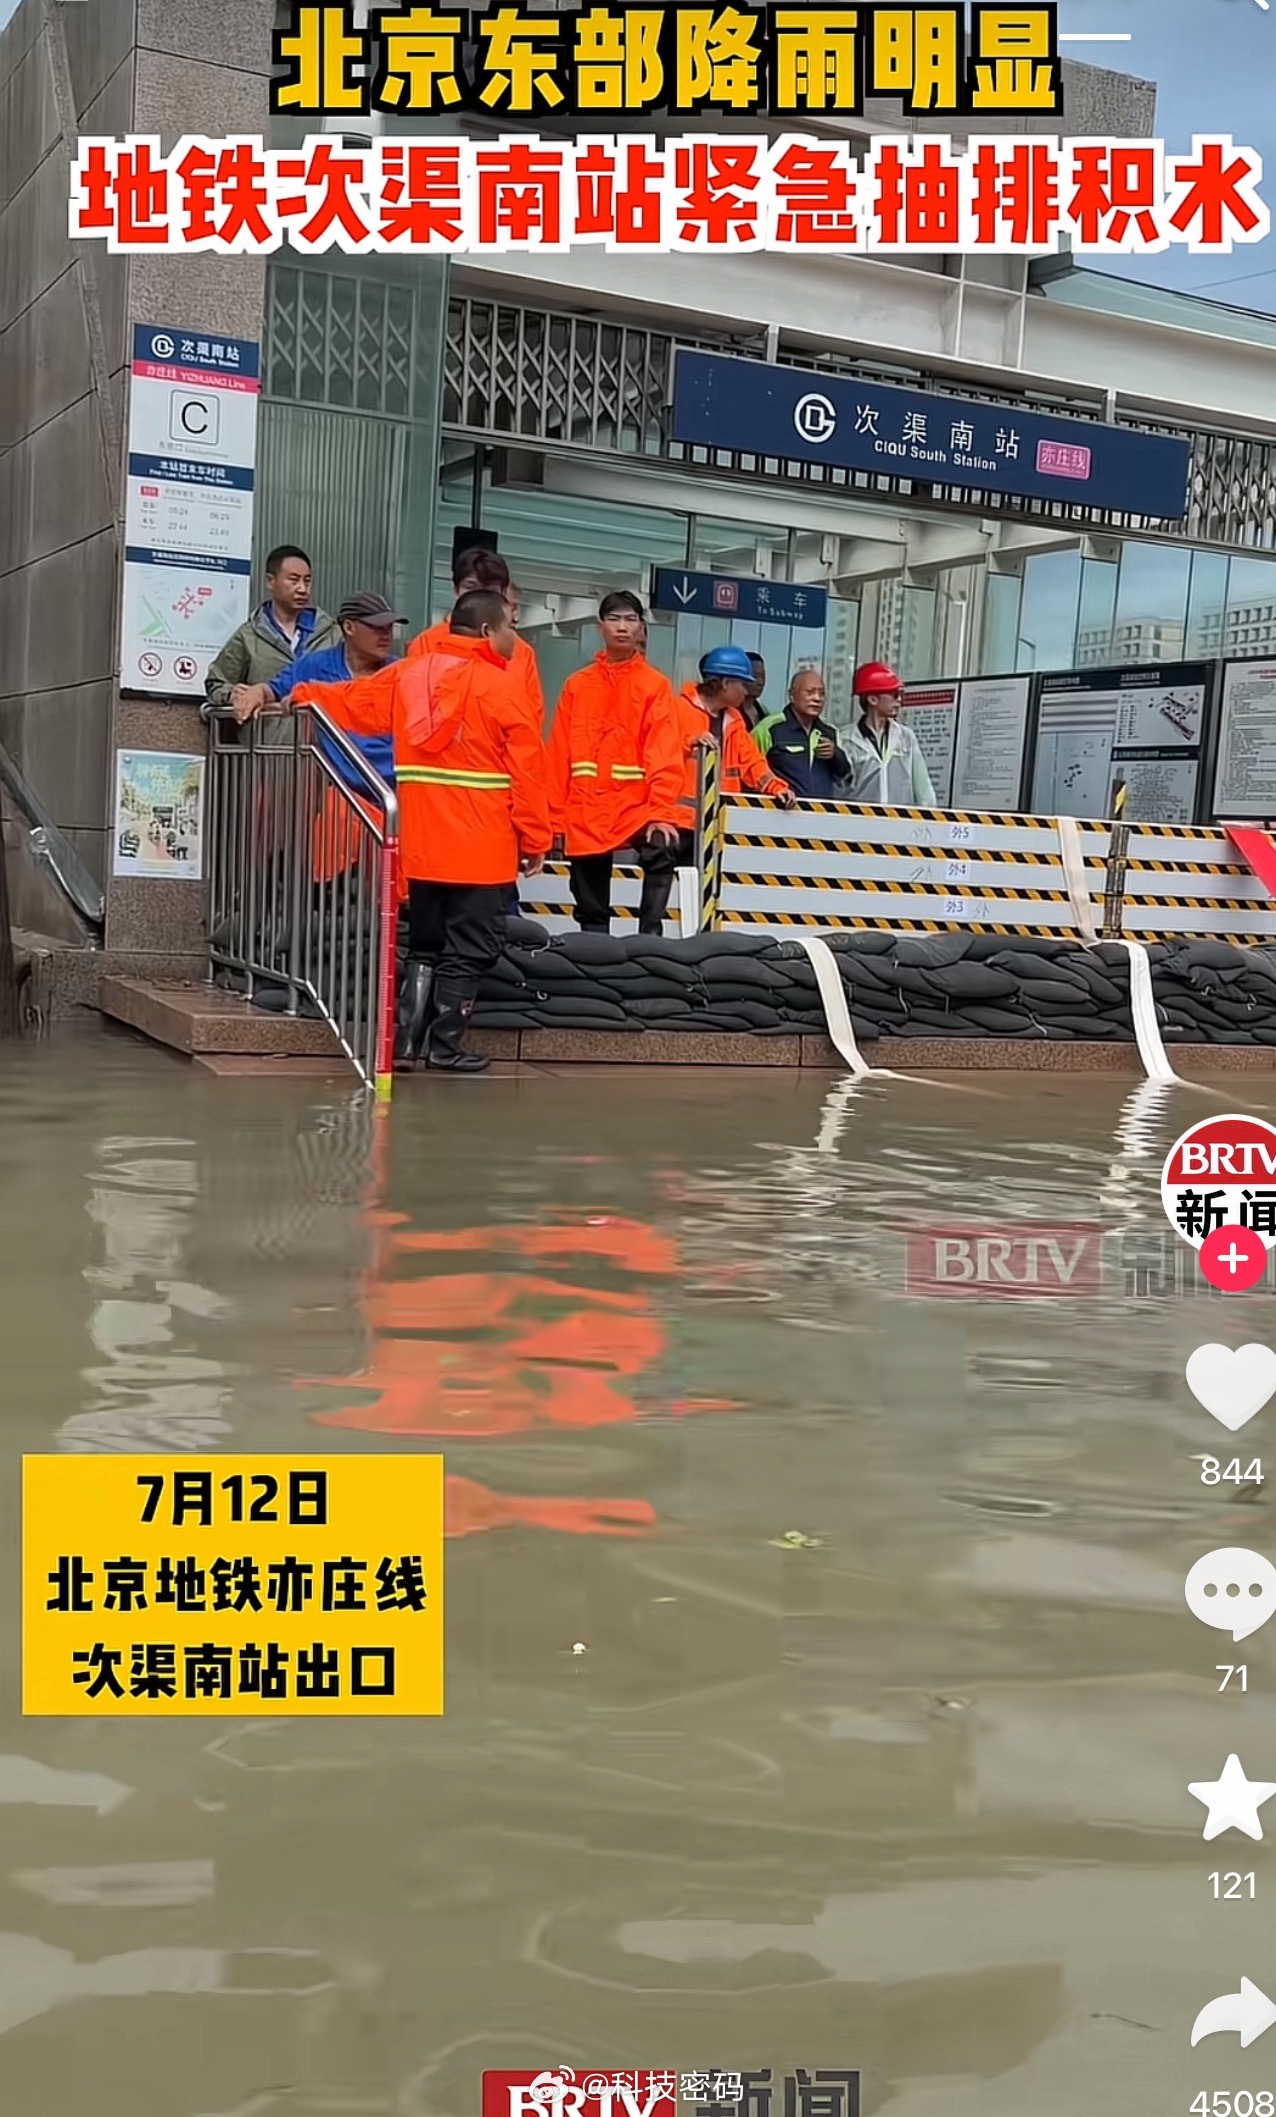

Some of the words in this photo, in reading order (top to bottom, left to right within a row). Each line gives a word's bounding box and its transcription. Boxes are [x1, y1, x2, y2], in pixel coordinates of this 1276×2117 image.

[181, 401, 209, 435] C
[854, 404, 1021, 459] 次渠南站
[874, 440, 907, 457] CIQU
[910, 446, 948, 463] South
[953, 453, 997, 471] Station
